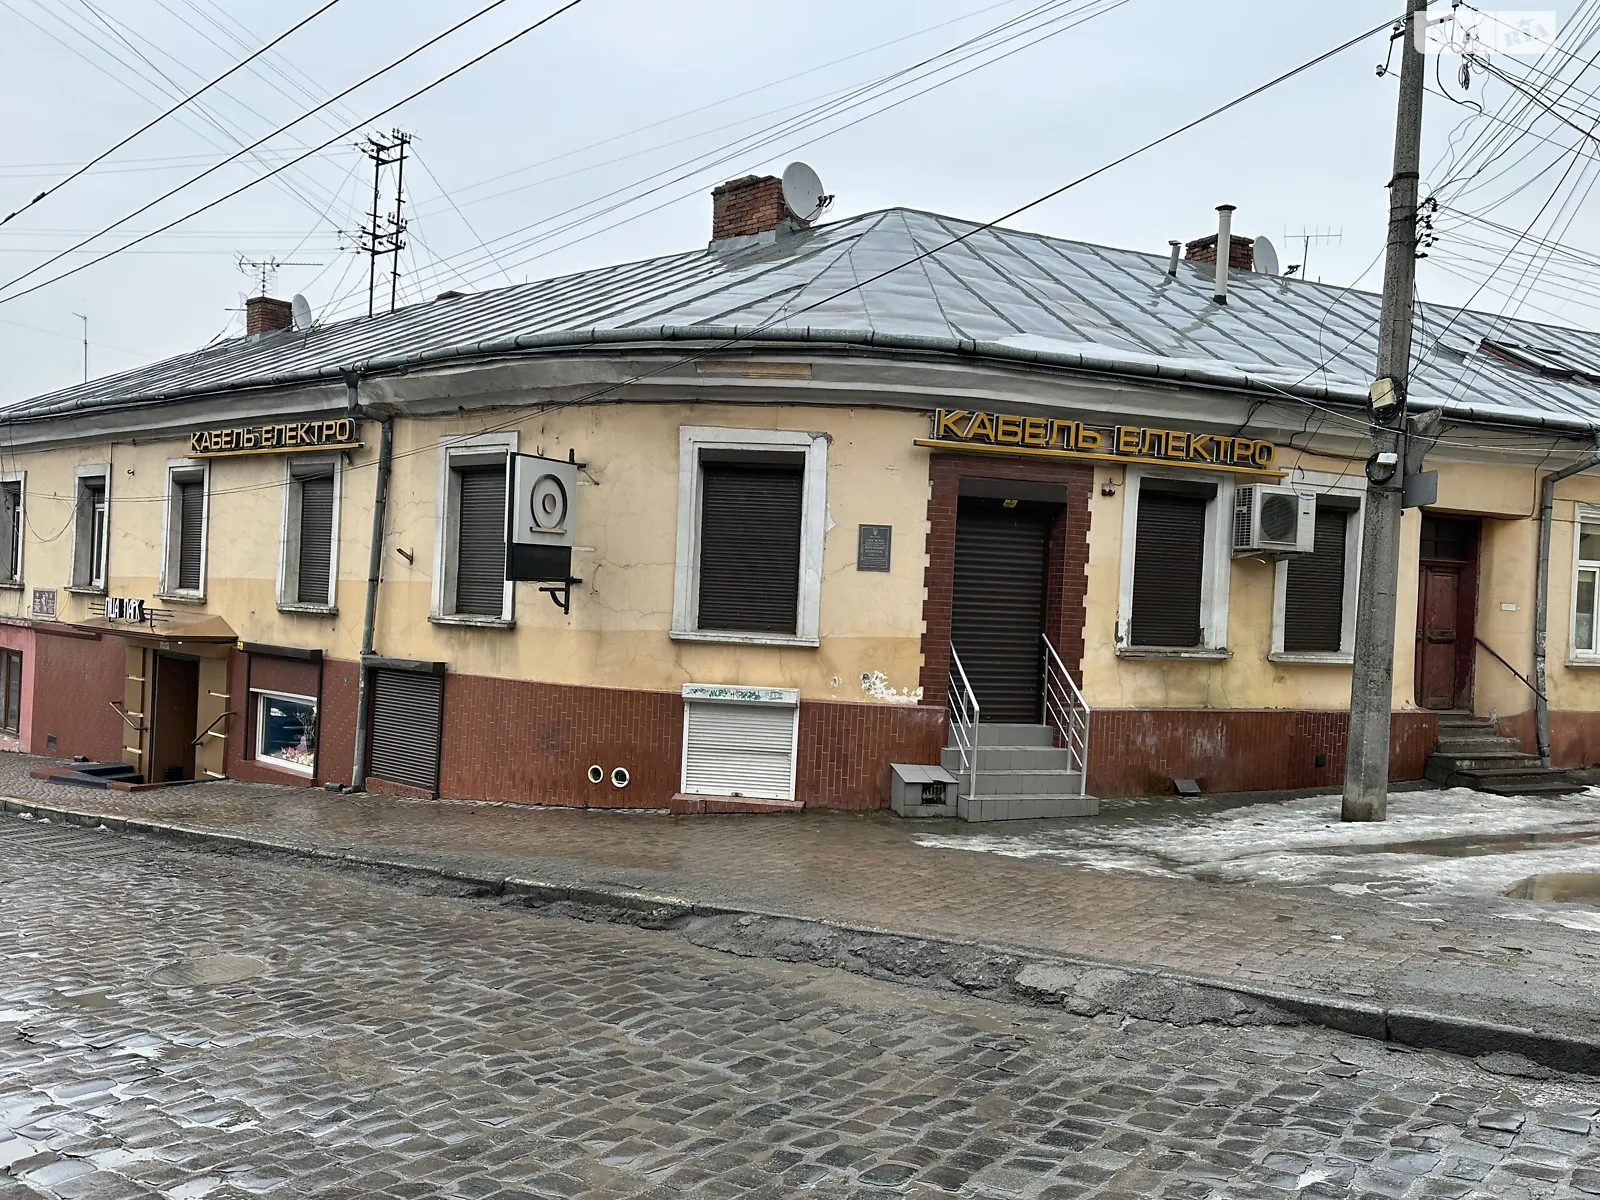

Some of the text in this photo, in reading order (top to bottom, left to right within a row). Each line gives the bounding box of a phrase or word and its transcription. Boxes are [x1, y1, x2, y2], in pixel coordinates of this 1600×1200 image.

[190, 418, 353, 451] КАБЕЛЬ ЕЛЕКТРО
[936, 408, 1275, 466] КАБЕЛЬ ЕЛЕКТРО
